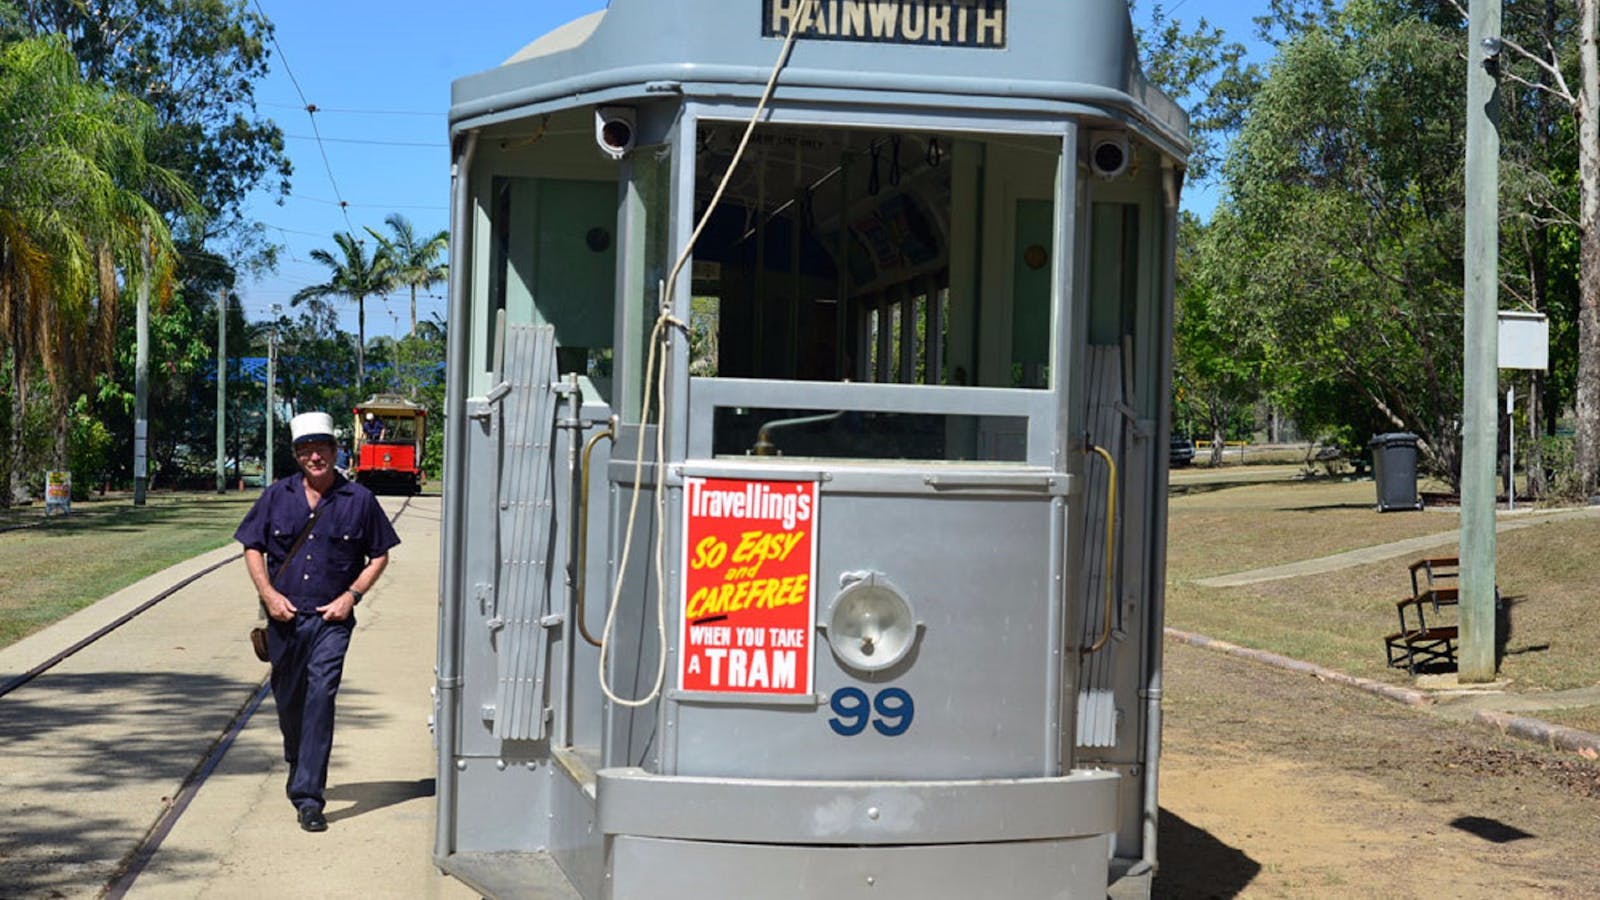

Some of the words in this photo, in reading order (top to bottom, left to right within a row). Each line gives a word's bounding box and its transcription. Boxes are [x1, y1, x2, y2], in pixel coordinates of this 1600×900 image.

[687, 477, 811, 530] Travelling's
[691, 535, 728, 570] SO
[731, 530, 805, 563] EASY
[724, 560, 763, 581] and
[686, 573, 809, 619] CAREFREE
[690, 625, 732, 646] WHEN
[736, 626, 766, 648] YOU
[768, 627, 805, 648] TAKE
[687, 653, 701, 675] A
[704, 647, 797, 690] TRAM
[828, 686, 915, 737] 99
